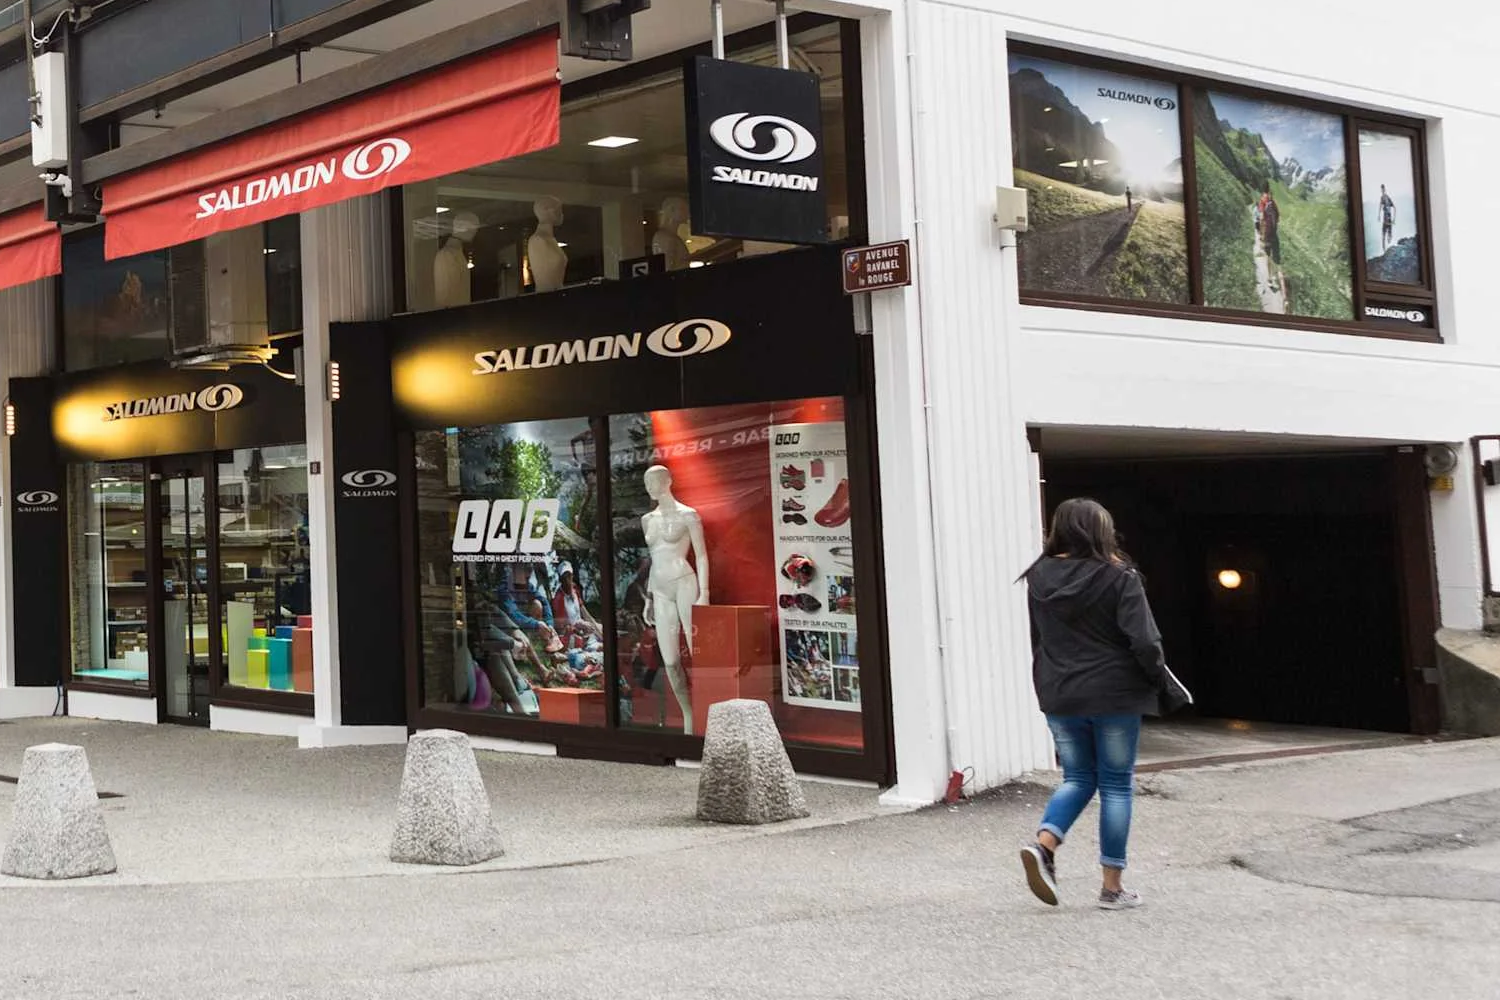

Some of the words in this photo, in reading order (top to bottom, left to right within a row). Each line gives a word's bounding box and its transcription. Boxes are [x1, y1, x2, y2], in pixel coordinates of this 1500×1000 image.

[1097, 88, 1152, 105] SALOMON
[711, 165, 818, 191] SALOMON
[196, 158, 336, 219] SALOMON
[865, 247, 899, 260] AVENUE
[866, 260, 899, 273] RAVANEL
[867, 272, 893, 285] ROUGE
[1364, 306, 1406, 319] SALOMON
[472, 332, 642, 375] SALOMON
[101, 392, 196, 421] SALOMON
[343, 490, 397, 498] SALOMON
[17, 505, 59, 513] SALOMON
[456, 503, 556, 548] LAB
